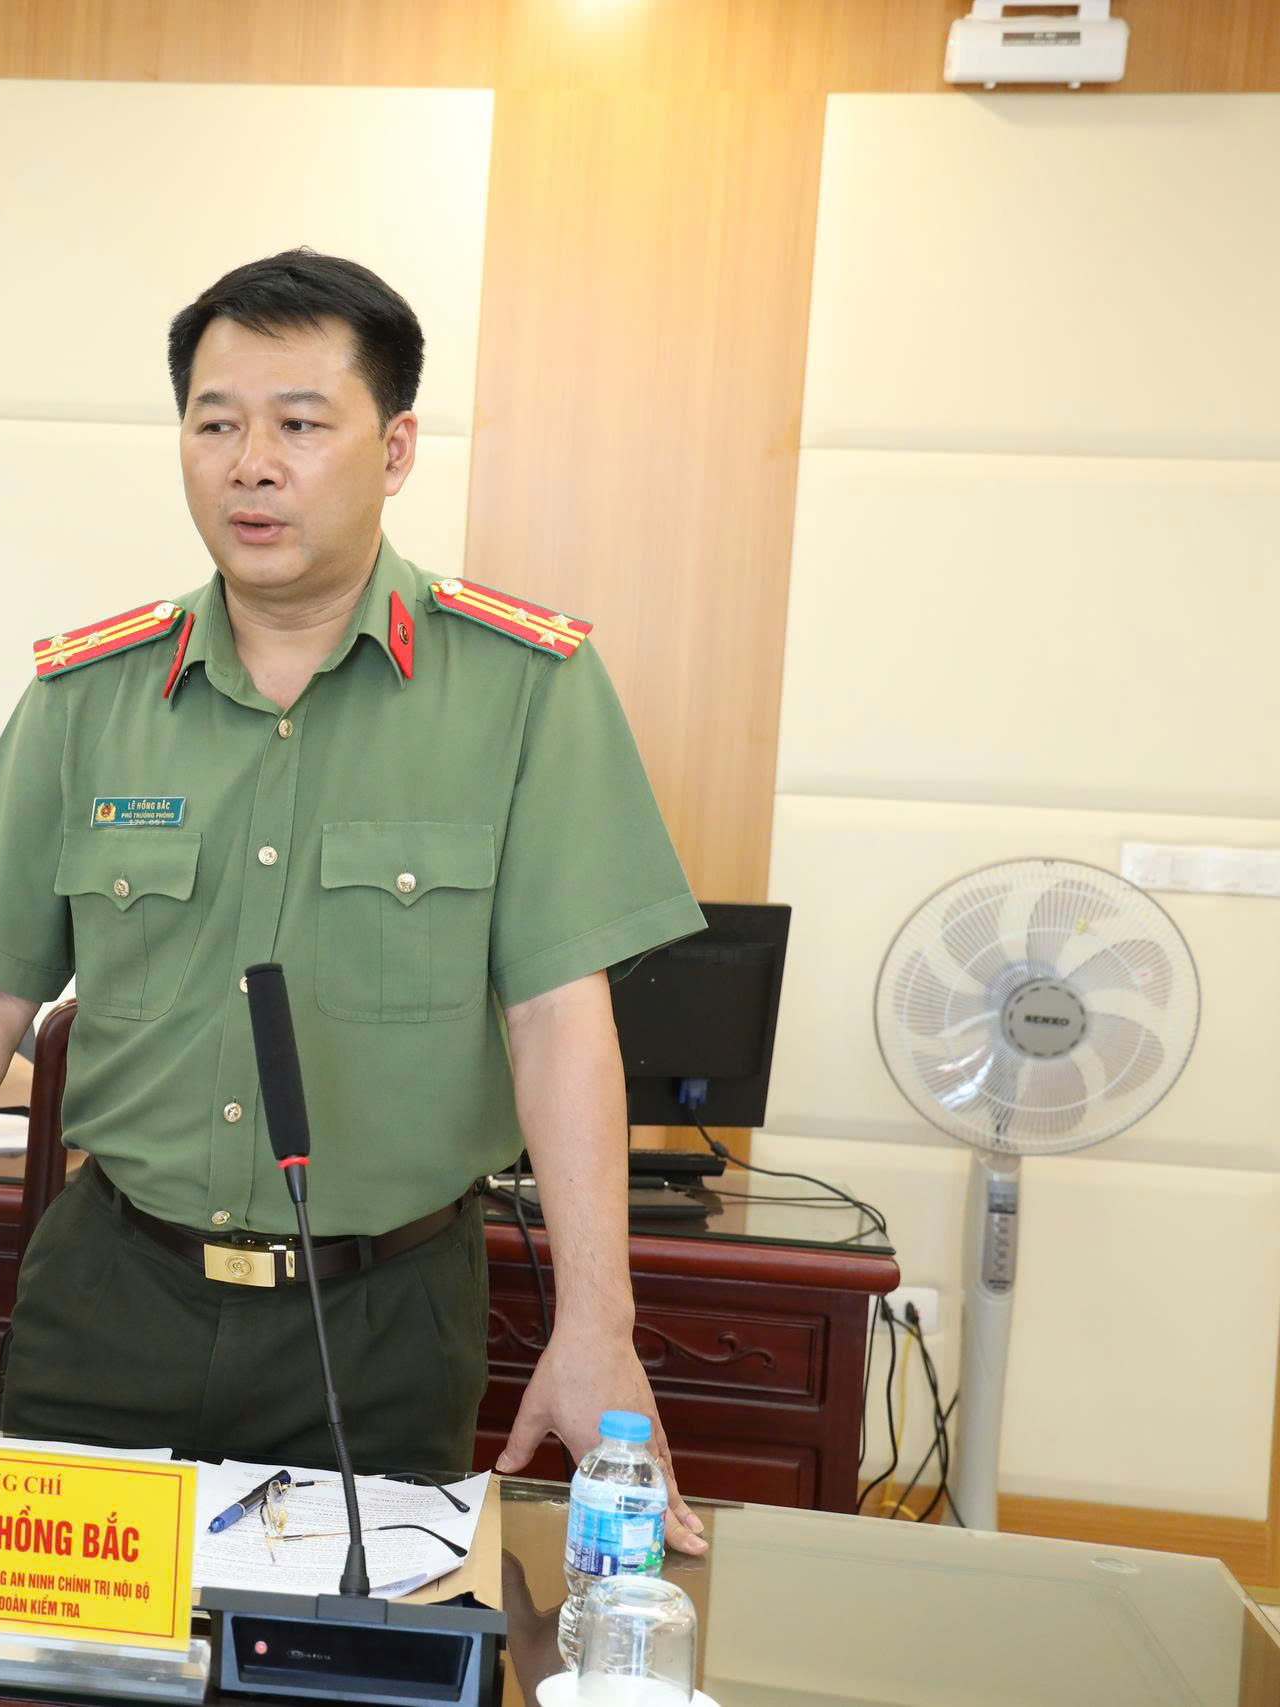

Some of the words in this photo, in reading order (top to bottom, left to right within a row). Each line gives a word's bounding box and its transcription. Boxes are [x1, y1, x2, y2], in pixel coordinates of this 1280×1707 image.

[24, 1473, 63, 1496] CHÍ
[82, 1511, 140, 1563] BẮC
[10, 1571, 26, 1588] AN
[28, 1573, 55, 1591] NINH
[58, 1574, 91, 1594] CHÍNH
[94, 1579, 110, 1600] TRỊ
[113, 1579, 132, 1602] NỘI
[135, 1581, 150, 1603] BỘ
[30, 1594, 58, 1616] KIỂM
[61, 1602, 81, 1619] TRA
